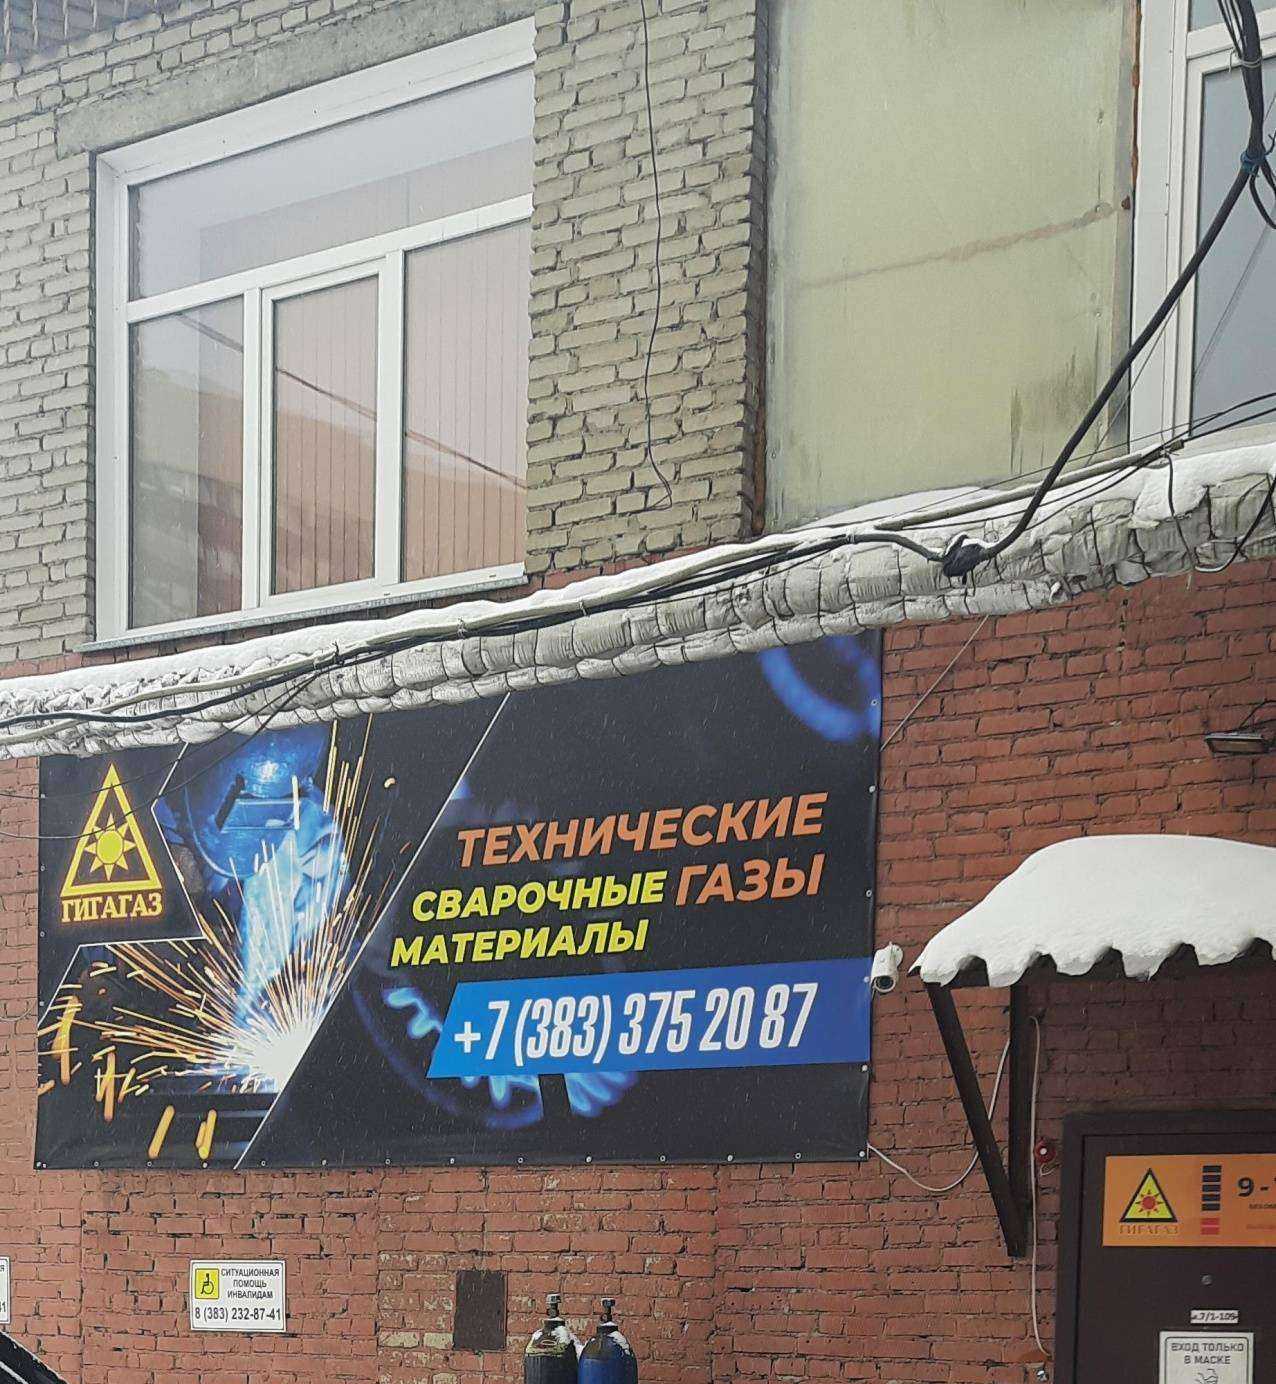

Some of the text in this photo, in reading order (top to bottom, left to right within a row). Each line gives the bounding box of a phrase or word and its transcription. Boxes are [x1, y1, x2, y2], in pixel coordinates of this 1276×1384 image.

[457, 792, 828, 868] ТЕХНИЧЕСКИЕ
[675, 854, 826, 906] ГАЗЫ
[61, 892, 163, 923] ГИГАГАЗ
[412, 870, 668, 922] СВАРОЧНЫЕ
[390, 919, 650, 967] МАТЕРИАЛЫ
[454, 983, 819, 1067] +7 (383) 375 20 87
[221, 1268, 280, 1277] СИТУАЦИОННАЯ
[233, 1279, 267, 1288] ПОМОЩЬ
[227, 1290, 274, 1299] ИНВАЛИДАМ
[195, 1307, 281, 1323] 8 (383) 232-87-41
[1171, 1342, 1245, 1353] ВХОД ТОЛЬКО
[1183, 1355, 1232, 1365] В МАСКЕ
